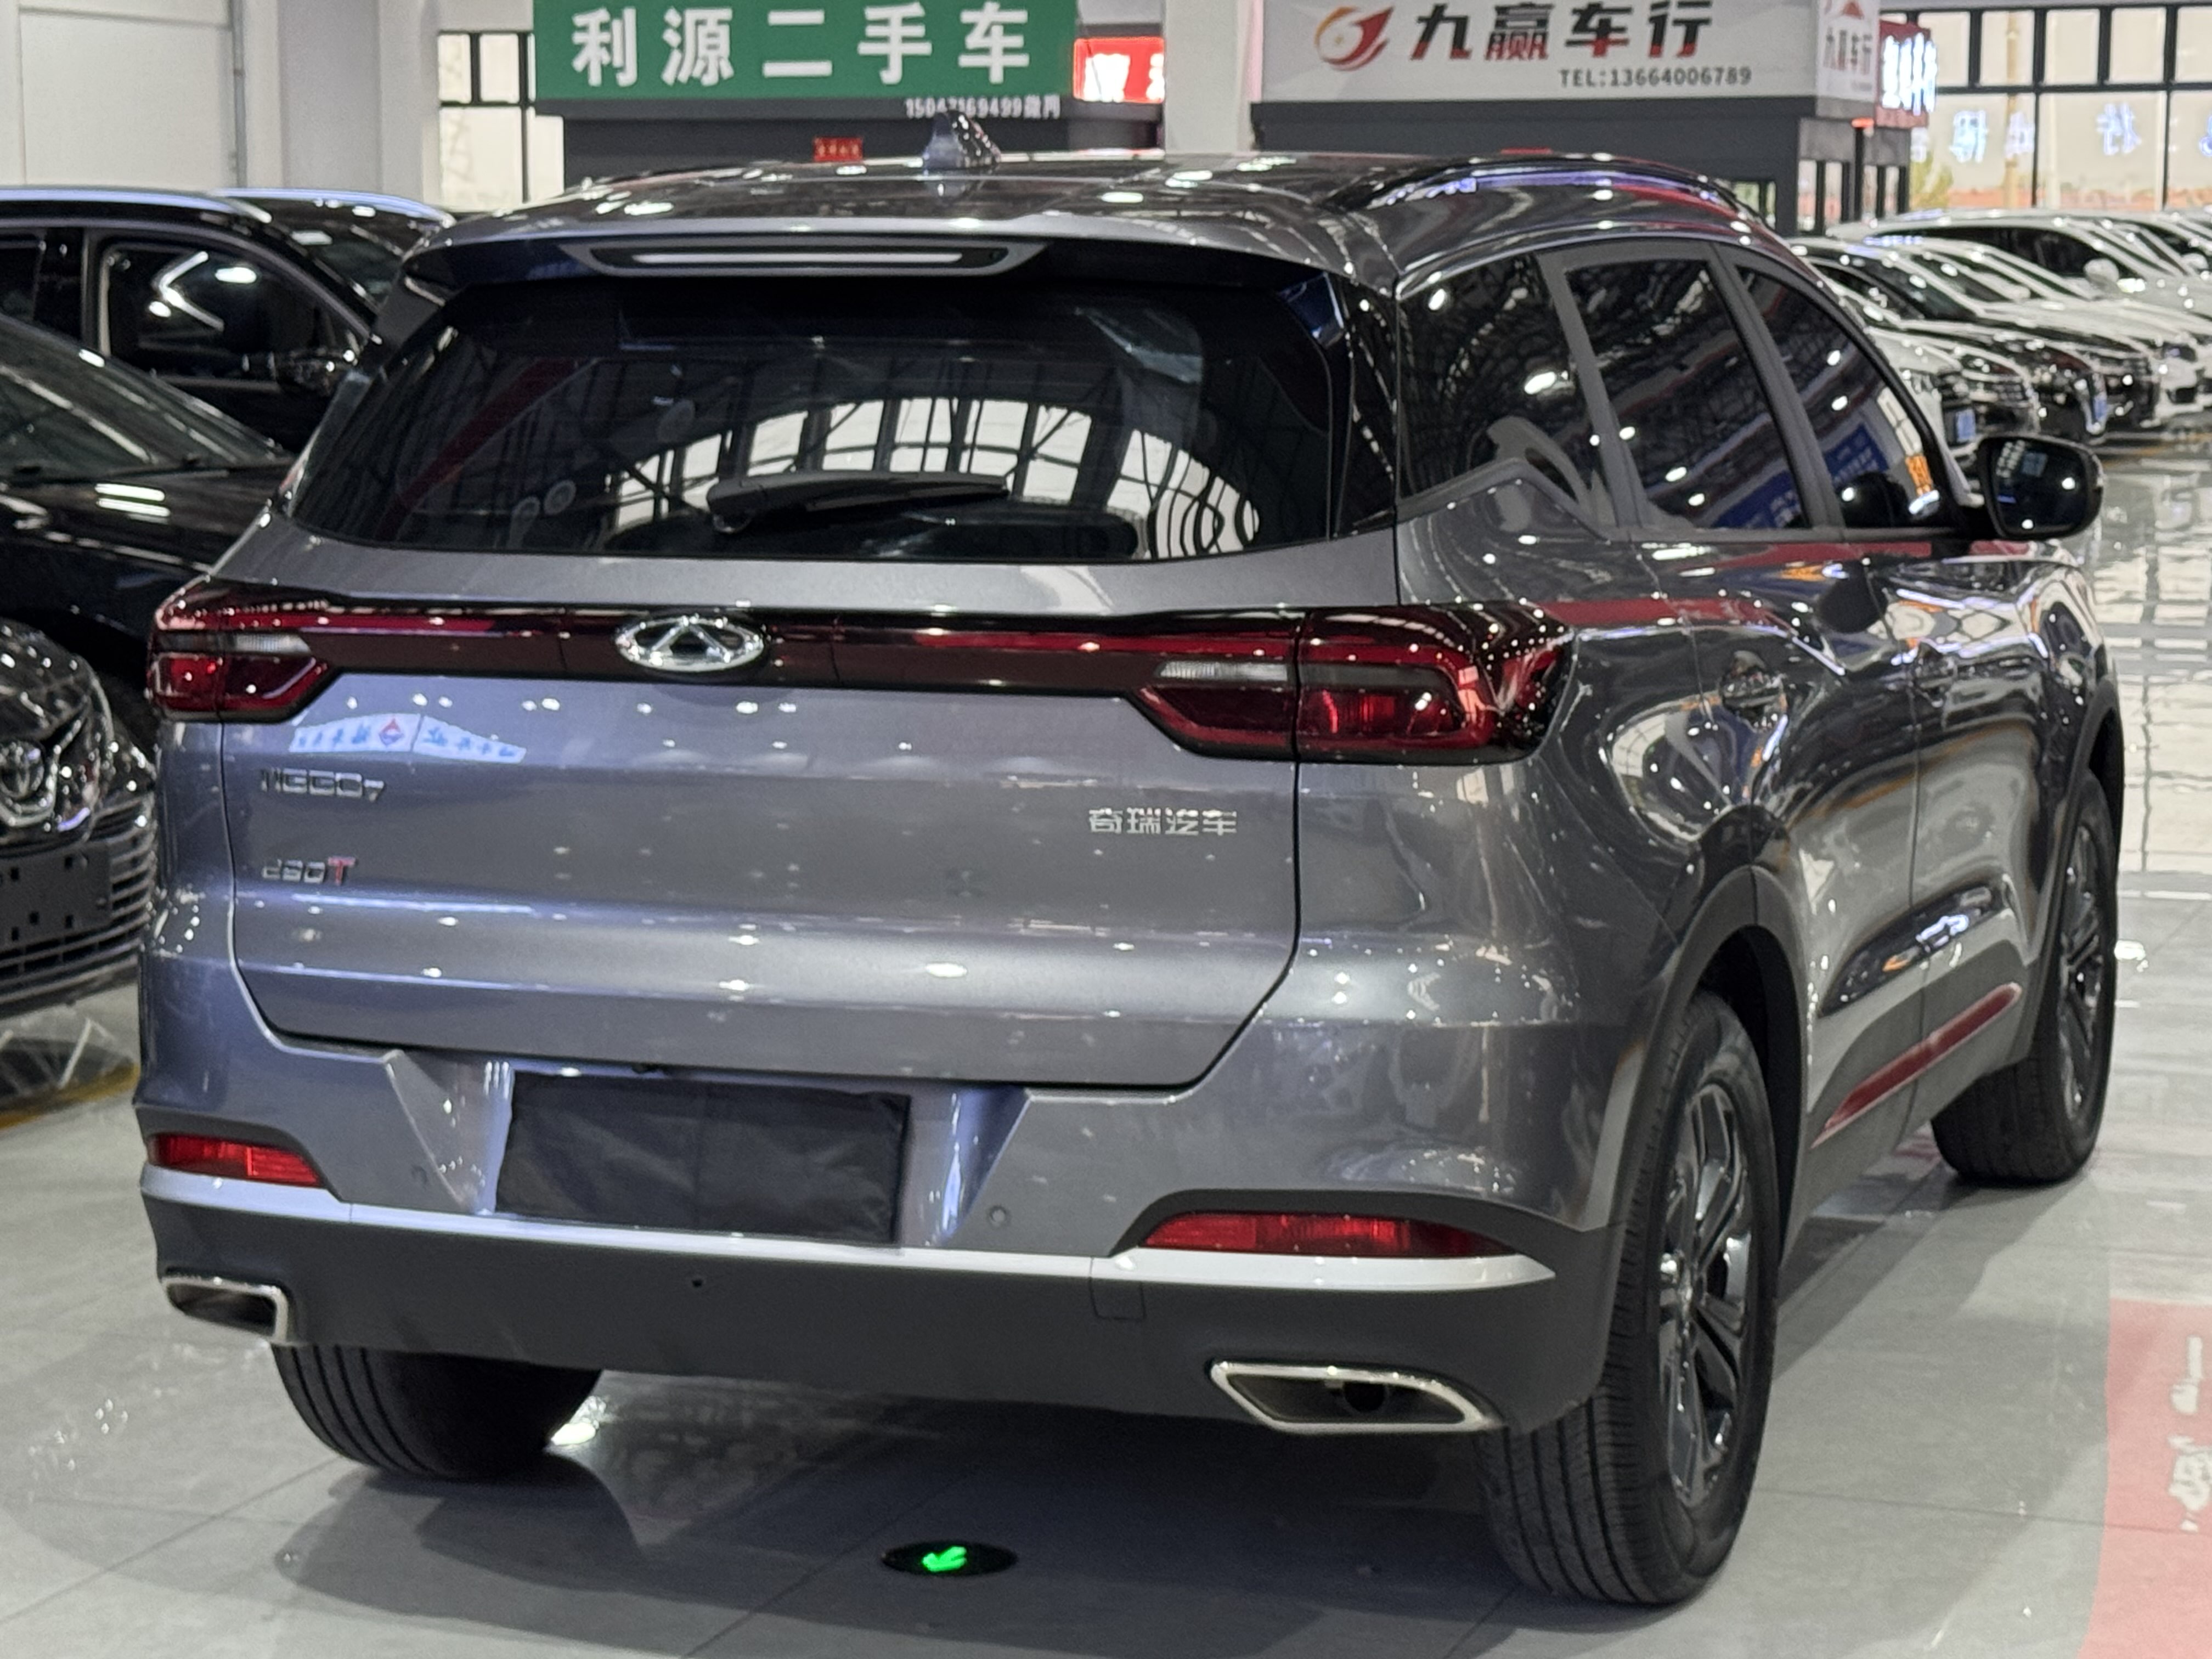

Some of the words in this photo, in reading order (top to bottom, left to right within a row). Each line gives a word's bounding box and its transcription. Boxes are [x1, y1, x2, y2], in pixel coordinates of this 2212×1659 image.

[572, 2, 1030, 87] 利源二手车
[1410, 1, 1713, 60] 九赢车行
[1089, 807, 1237, 836] 奇瑞汽车
